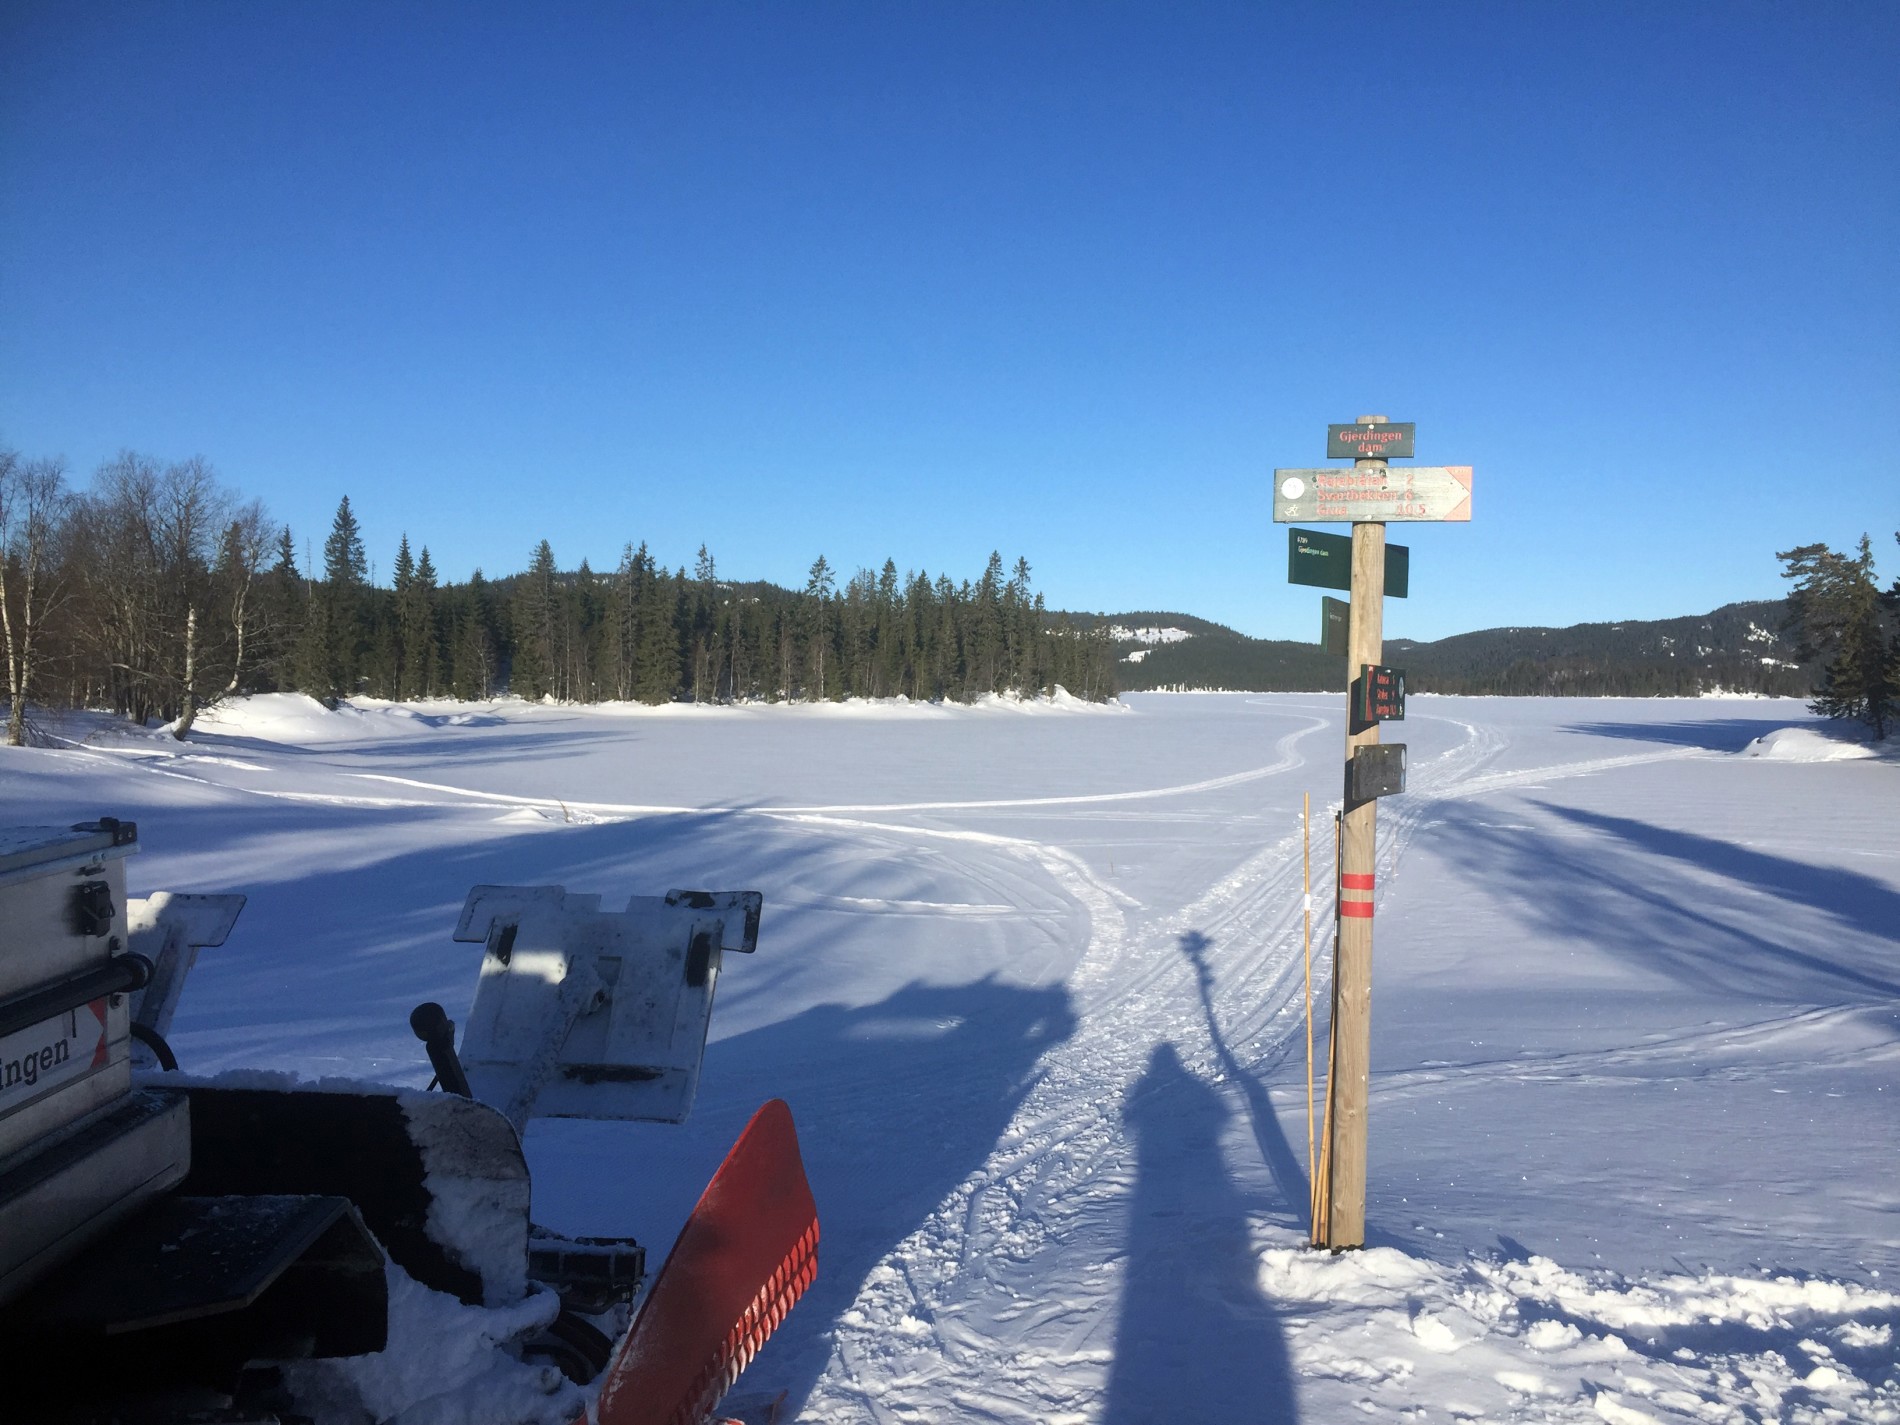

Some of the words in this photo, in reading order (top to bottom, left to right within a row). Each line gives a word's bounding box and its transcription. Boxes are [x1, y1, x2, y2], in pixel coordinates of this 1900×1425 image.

[1339, 430, 1402, 443] Gjerdingen
[1358, 442, 1382, 452] dam
[1405, 489, 1414, 500] 6
